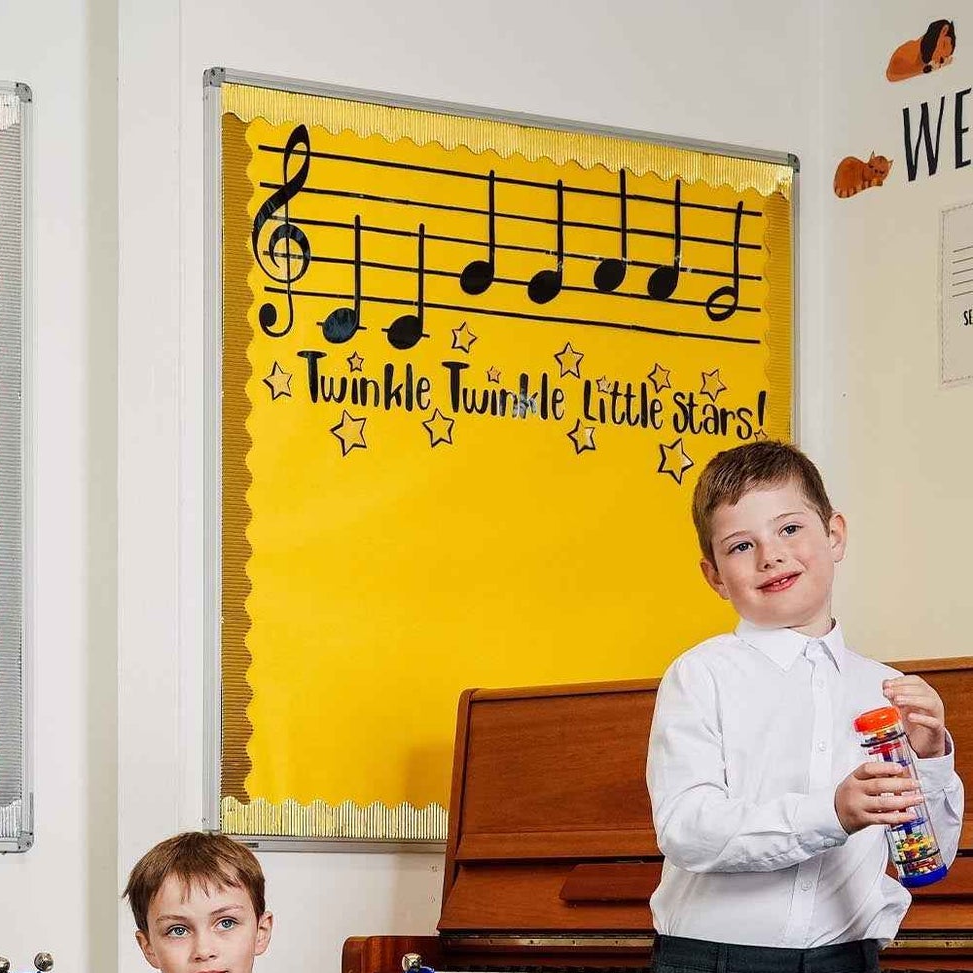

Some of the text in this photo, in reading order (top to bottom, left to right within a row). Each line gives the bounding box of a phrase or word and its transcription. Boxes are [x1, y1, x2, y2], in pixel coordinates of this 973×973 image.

[902, 87, 972, 182] WE
[296, 350, 432, 412] Twinkle
[441, 361, 565, 421] Twinkle
[582, 382, 664, 431] Little
